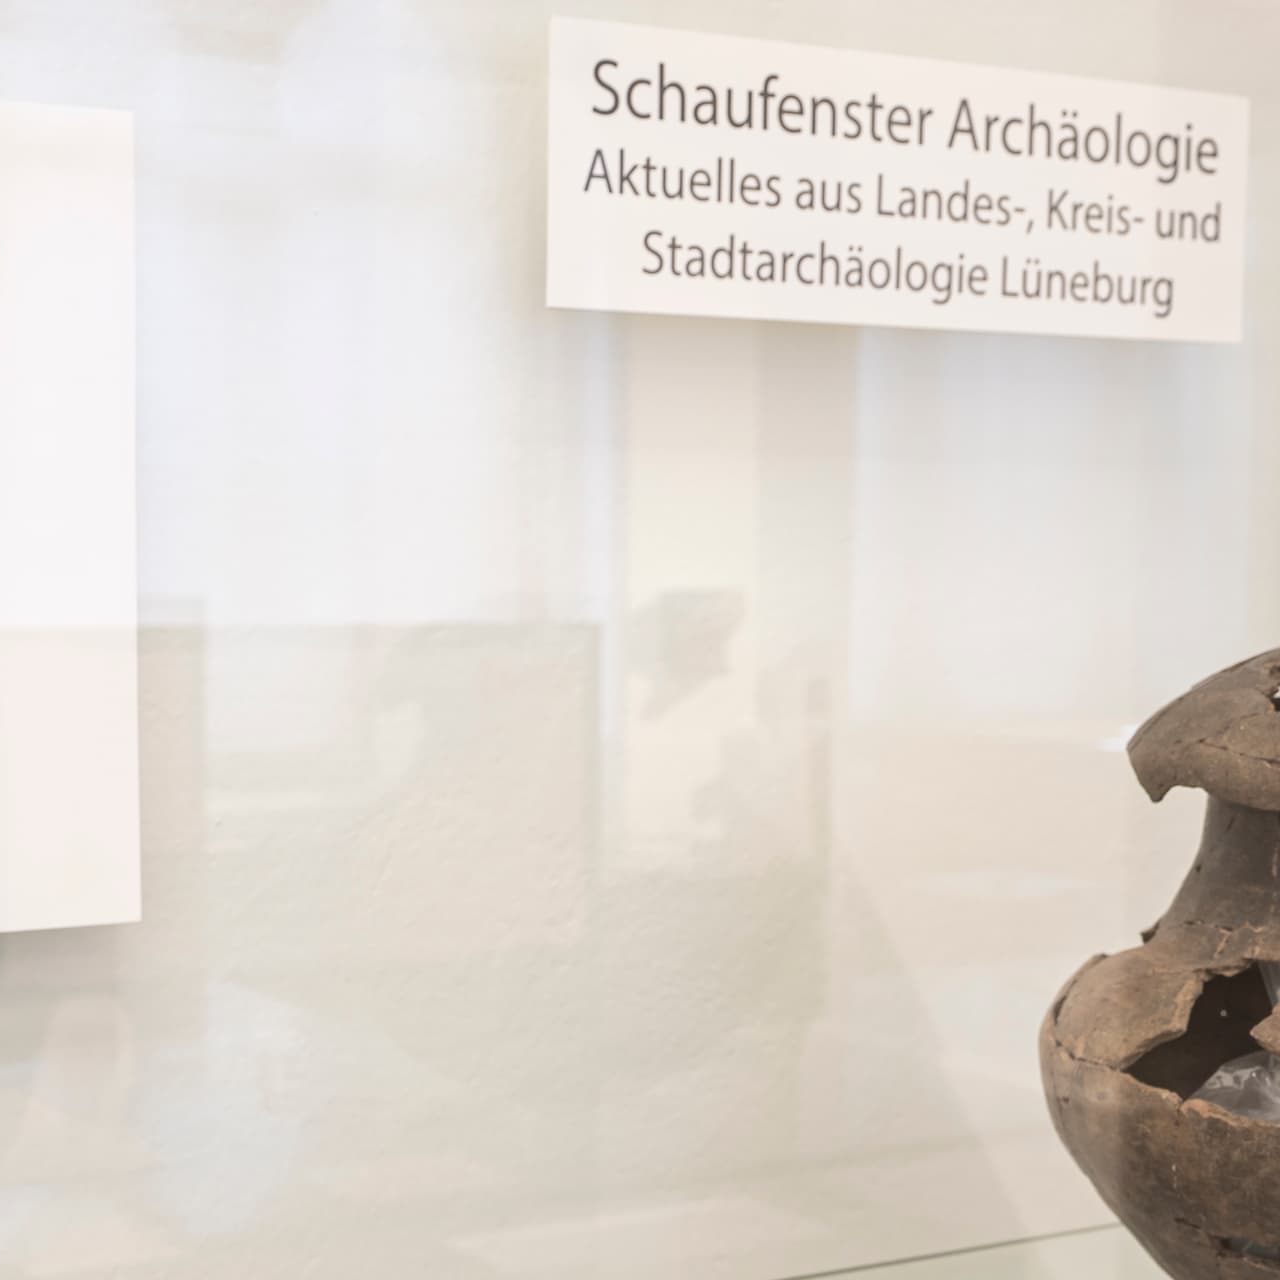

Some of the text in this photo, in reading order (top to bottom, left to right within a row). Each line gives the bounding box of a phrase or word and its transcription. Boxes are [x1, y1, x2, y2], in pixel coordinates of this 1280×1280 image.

[591, 59, 1220, 184] Schaufenster Archäologie
[584, 148, 1222, 243] Aktuelles aus Landes-, Kreis- und
[642, 230, 1174, 318] Stadtarchäologie Lüneburg
